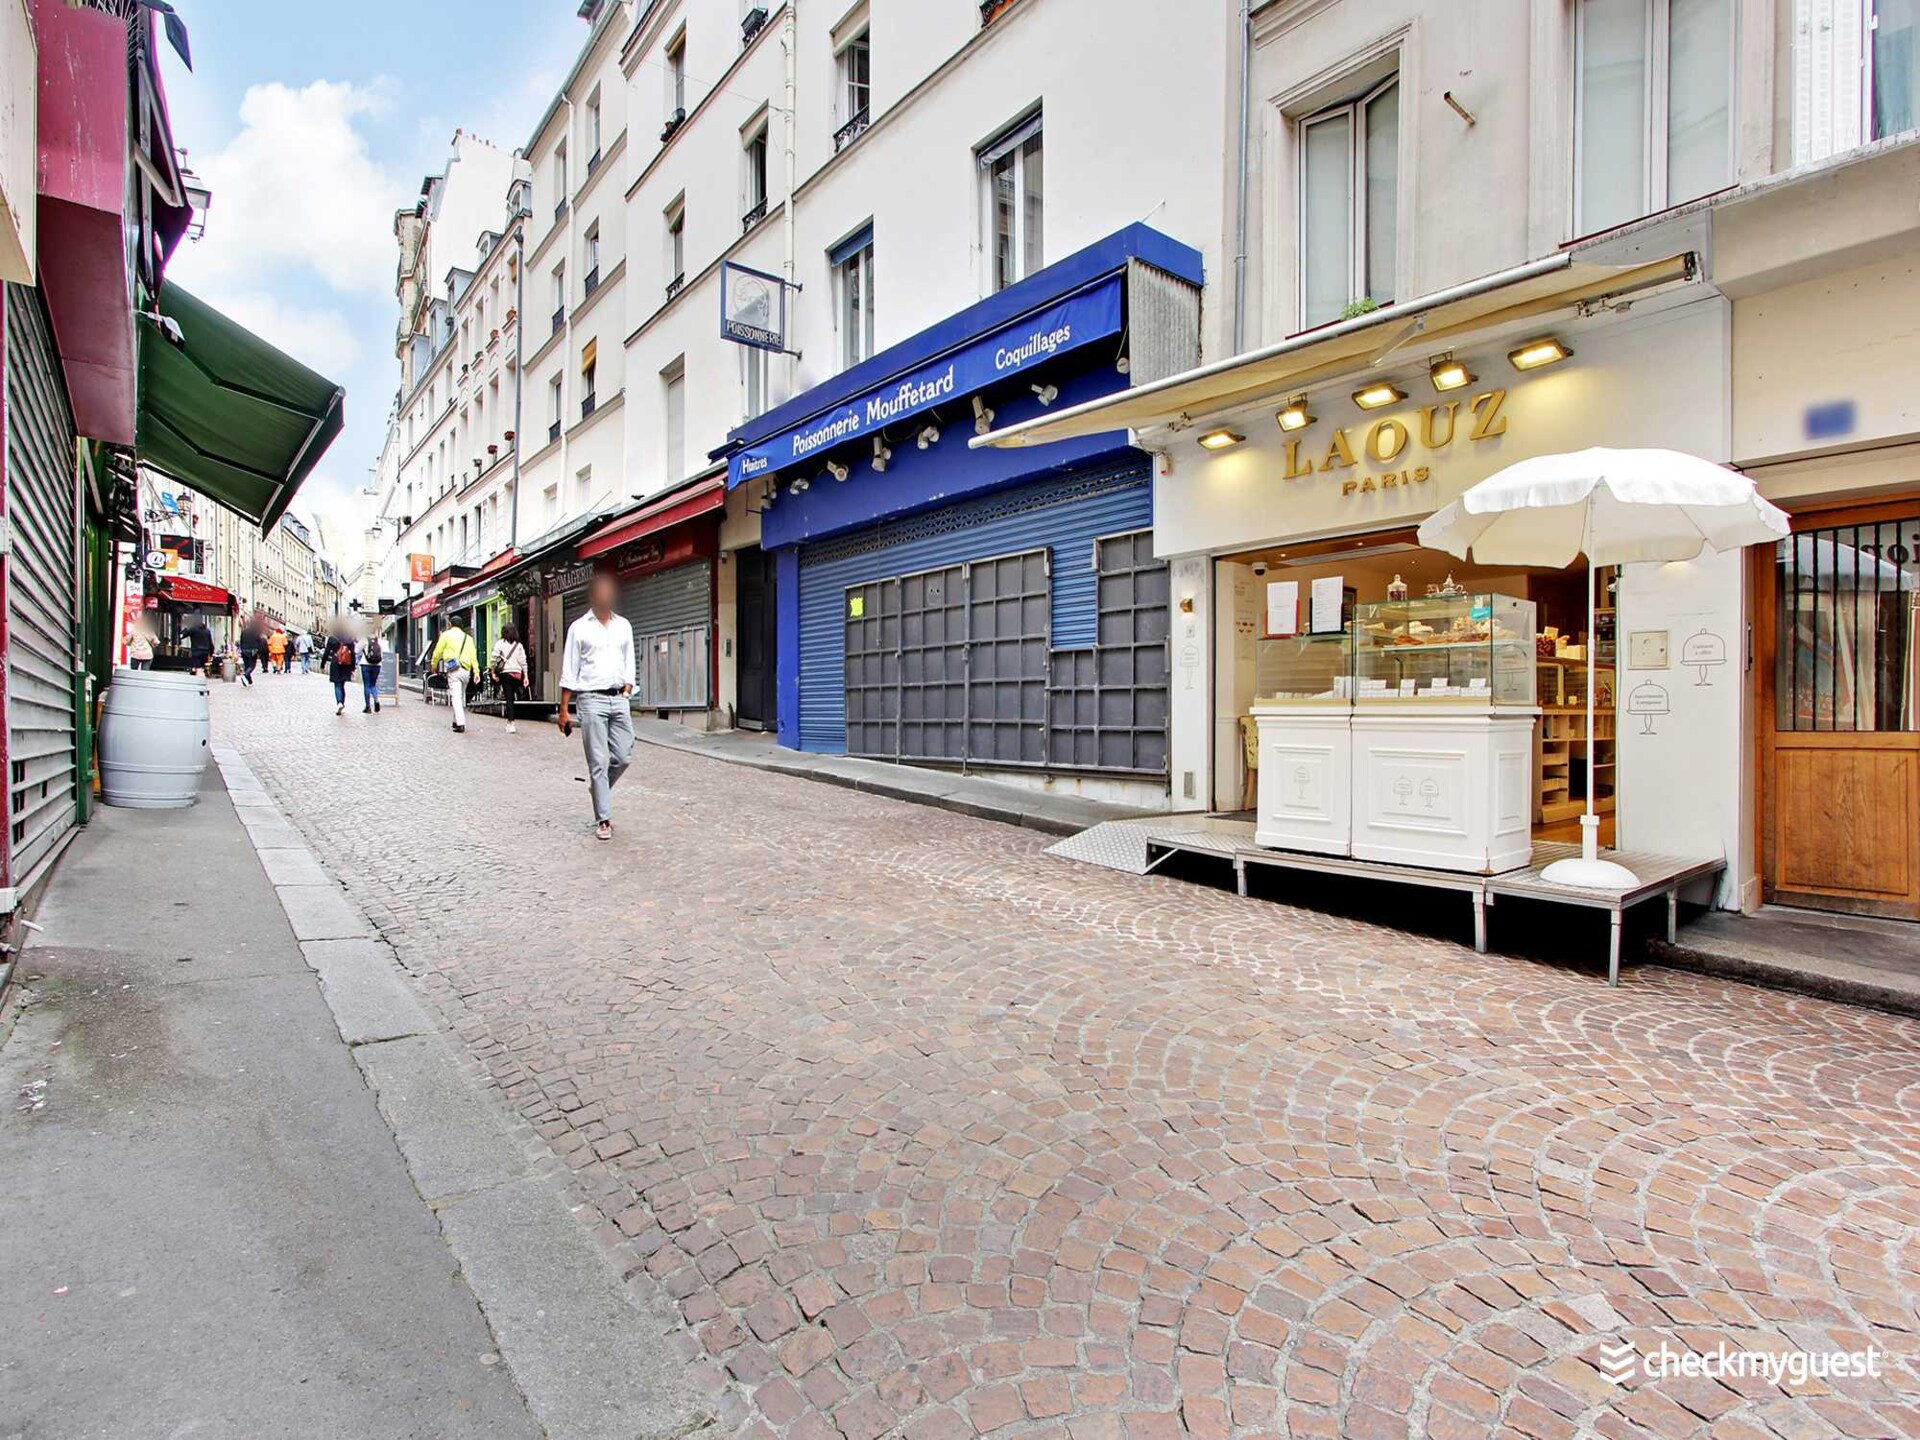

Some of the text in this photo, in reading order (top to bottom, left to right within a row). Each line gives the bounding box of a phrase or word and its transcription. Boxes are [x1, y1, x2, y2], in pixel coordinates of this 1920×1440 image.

[726, 320, 781, 345] POISSONNERIE
[995, 325, 1071, 370] Coquillages
[792, 364, 954, 456] Poissonnerie Mouffetard
[1282, 389, 1507, 481] LAOUZ
[1342, 466, 1430, 496] PARIS
